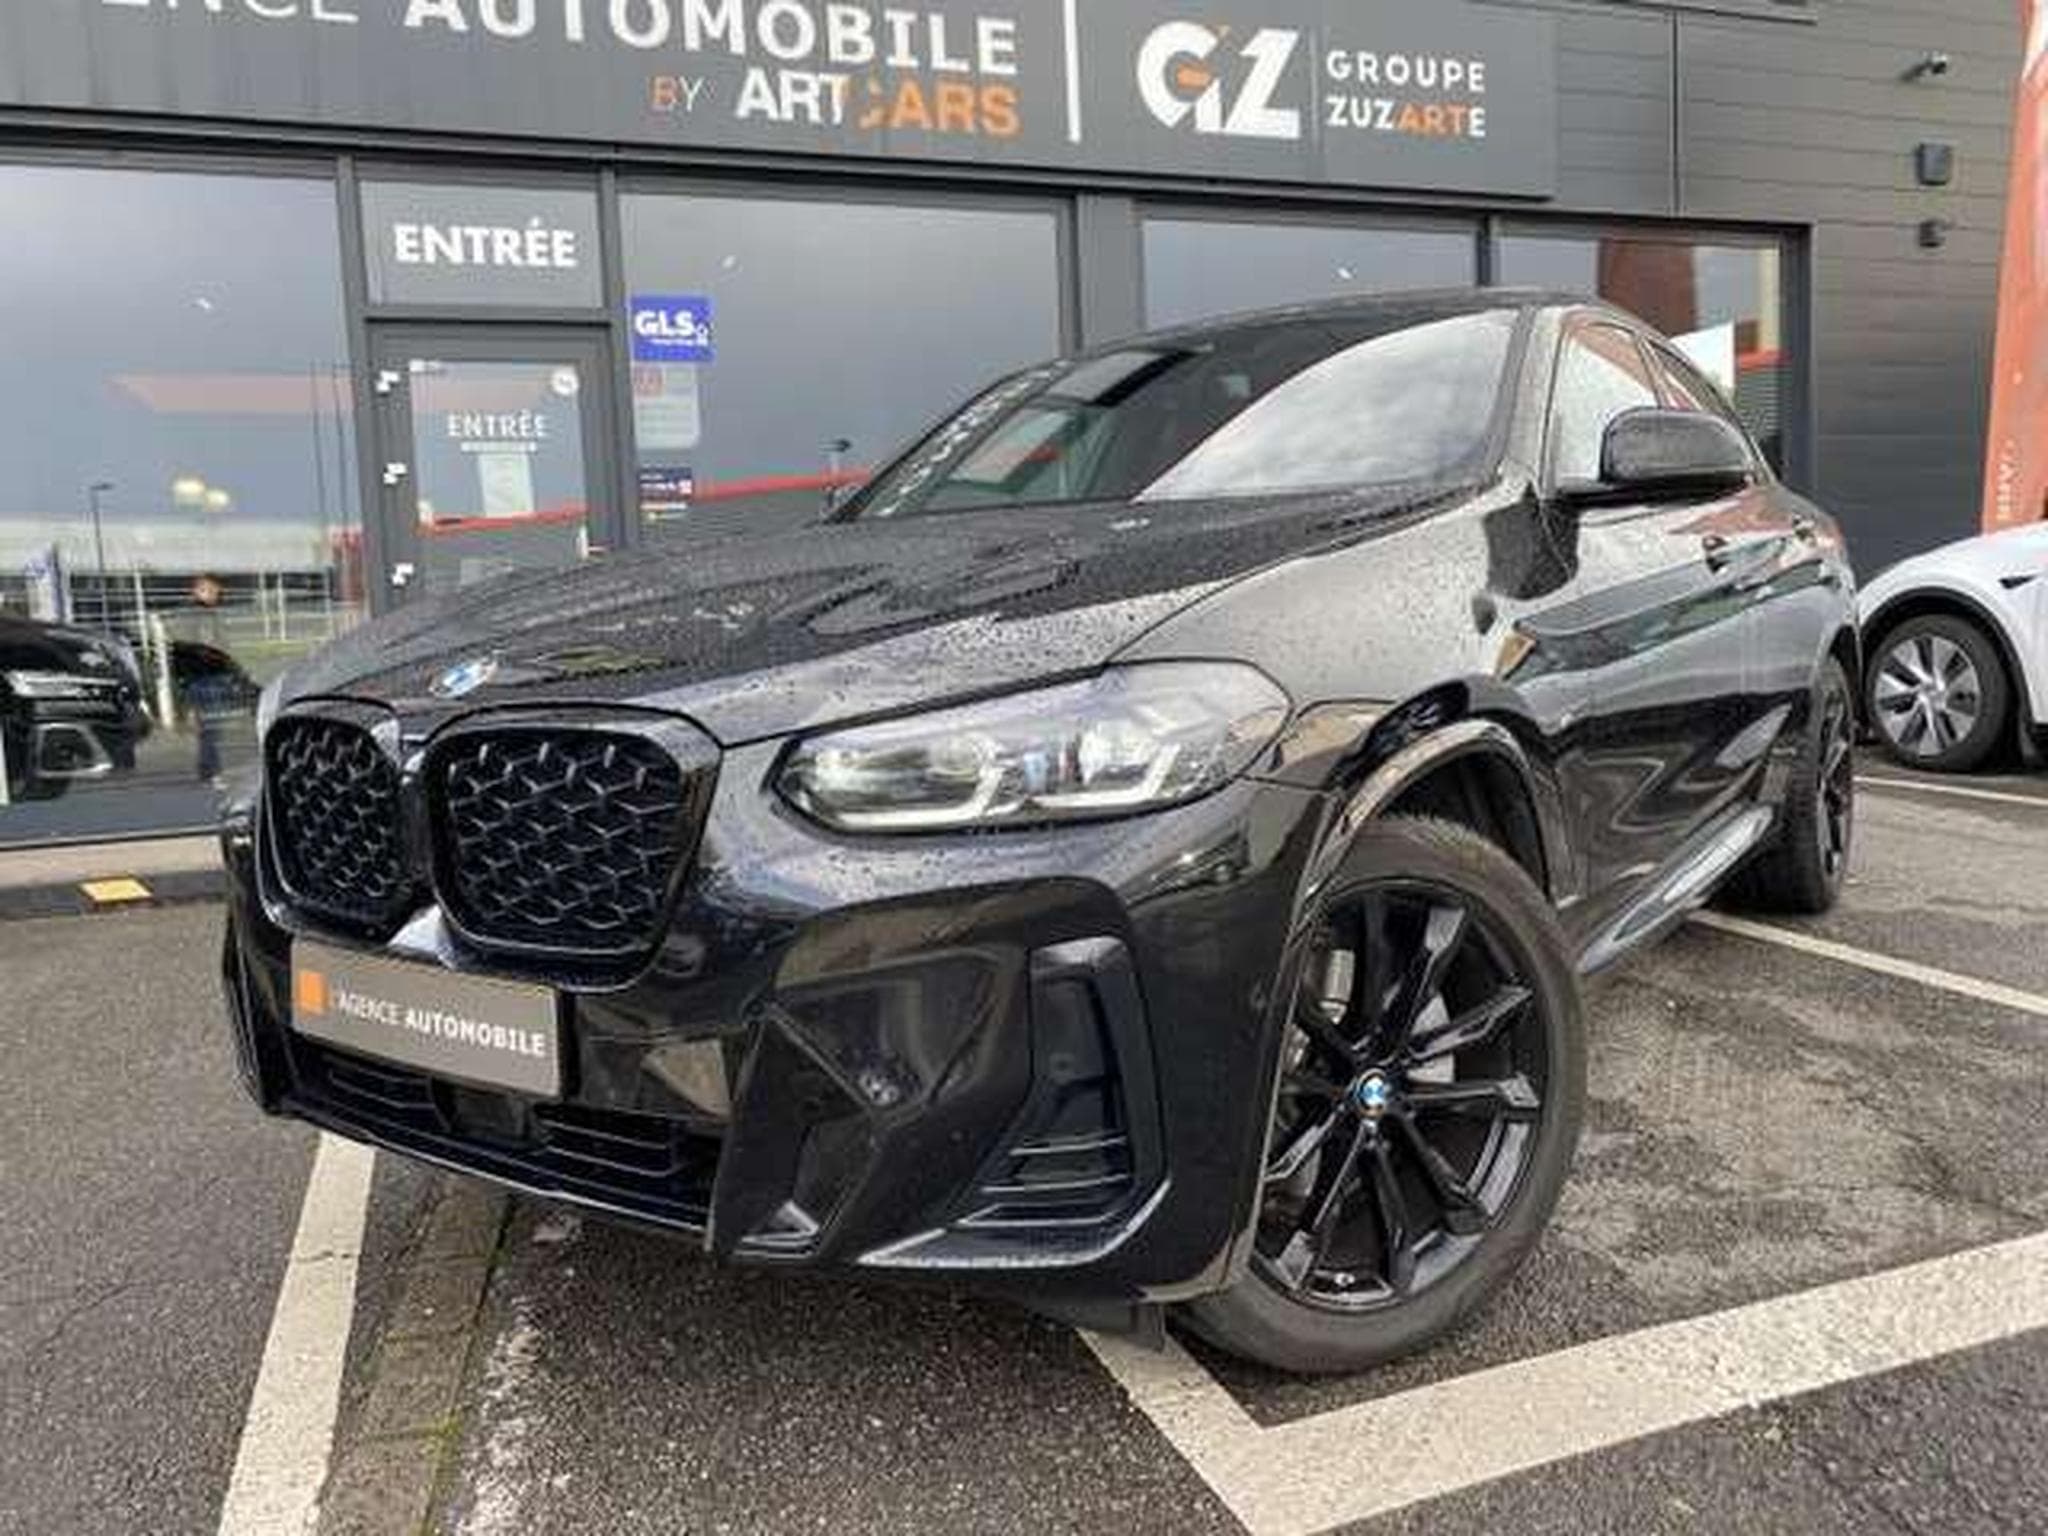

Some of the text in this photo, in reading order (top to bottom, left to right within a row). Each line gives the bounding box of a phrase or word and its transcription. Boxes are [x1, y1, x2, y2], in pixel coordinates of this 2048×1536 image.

[1325, 50, 1486, 93] GROUPE
[651, 76, 705, 113] BY
[1325, 97, 1486, 138] ZUZARTE
[394, 216, 577, 267] ENTRÉE
[635, 310, 695, 336] GLS
[447, 408, 550, 437] ENTRÉE
[404, 1008, 546, 1057] AUTOMOBILE
